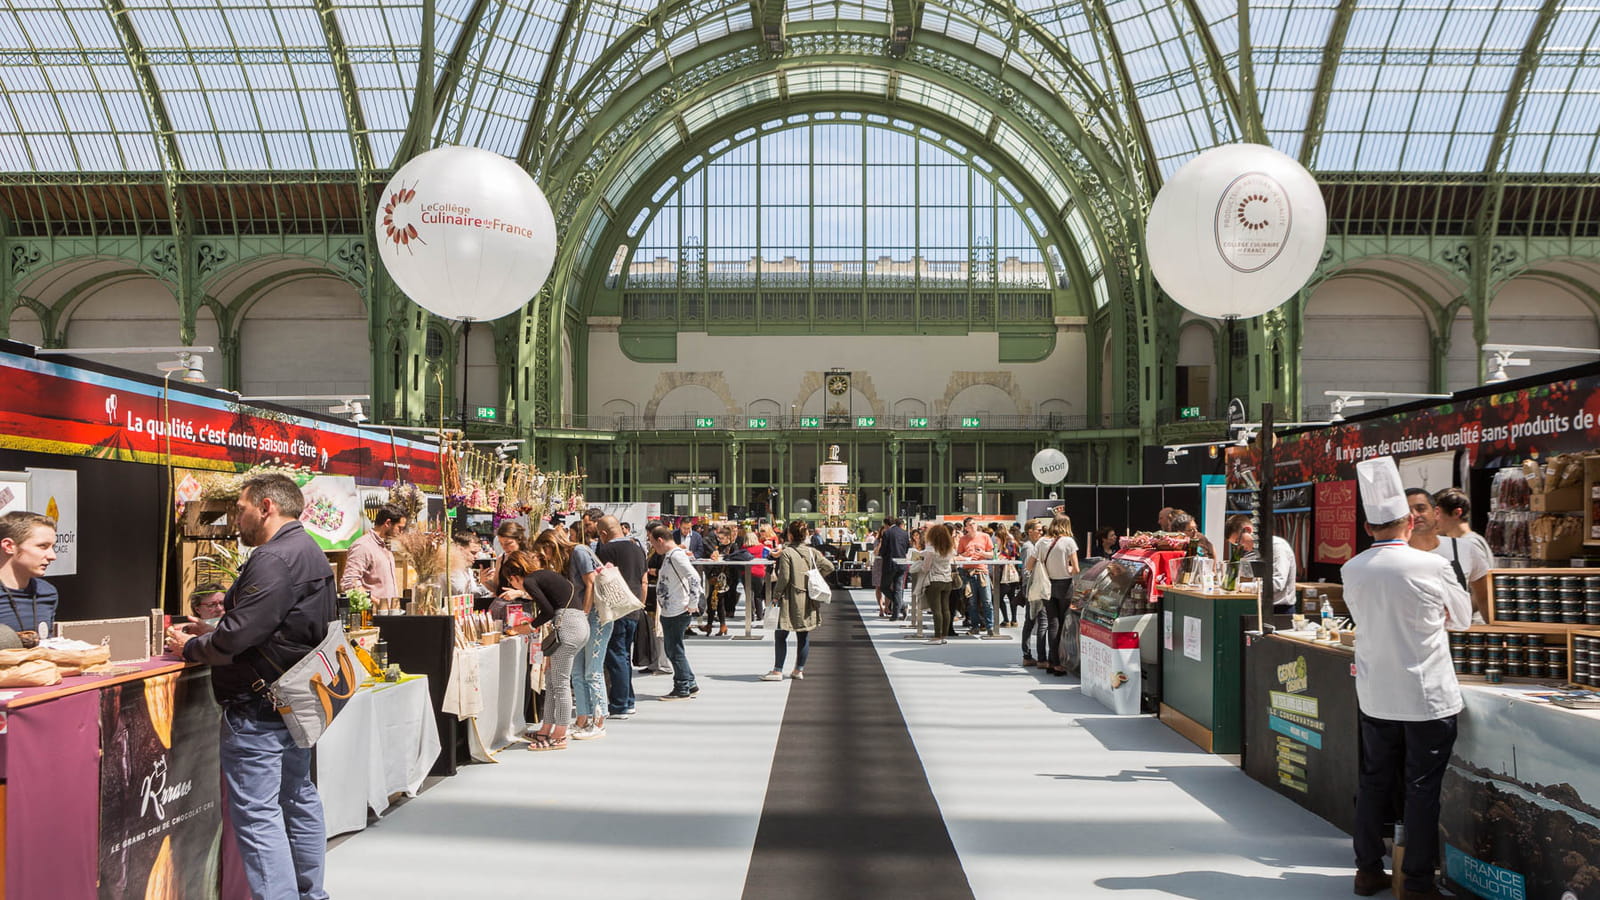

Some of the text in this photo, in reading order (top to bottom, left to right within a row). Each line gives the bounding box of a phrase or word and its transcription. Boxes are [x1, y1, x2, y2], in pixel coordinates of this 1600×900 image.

[421, 211, 534, 239] Culinaire de France
[127, 410, 143, 432] La
[199, 424, 226, 445] c'est
[229, 431, 257, 449] notre
[259, 434, 289, 454] saison
[290, 438, 317, 458] d'être
[1336, 446, 1343, 461] Il
[1343, 445, 1355, 465] n'y
[1356, 447, 1362, 457] a
[1362, 445, 1377, 461] pas
[1378, 440, 1390, 456] de
[1391, 434, 1425, 454] cuisine
[1426, 431, 1440, 450] de
[1441, 425, 1479, 451] qualité
[1481, 425, 1509, 443] sans
[1511, 413, 1570, 442] produits
[1573, 409, 1593, 430] de
[110, 800, 215, 854] LE GRAND CRU DE CHOCOLAT CRU
[1463, 855, 1522, 888] FRANCE
[1464, 870, 1523, 900] HALIOTIS
